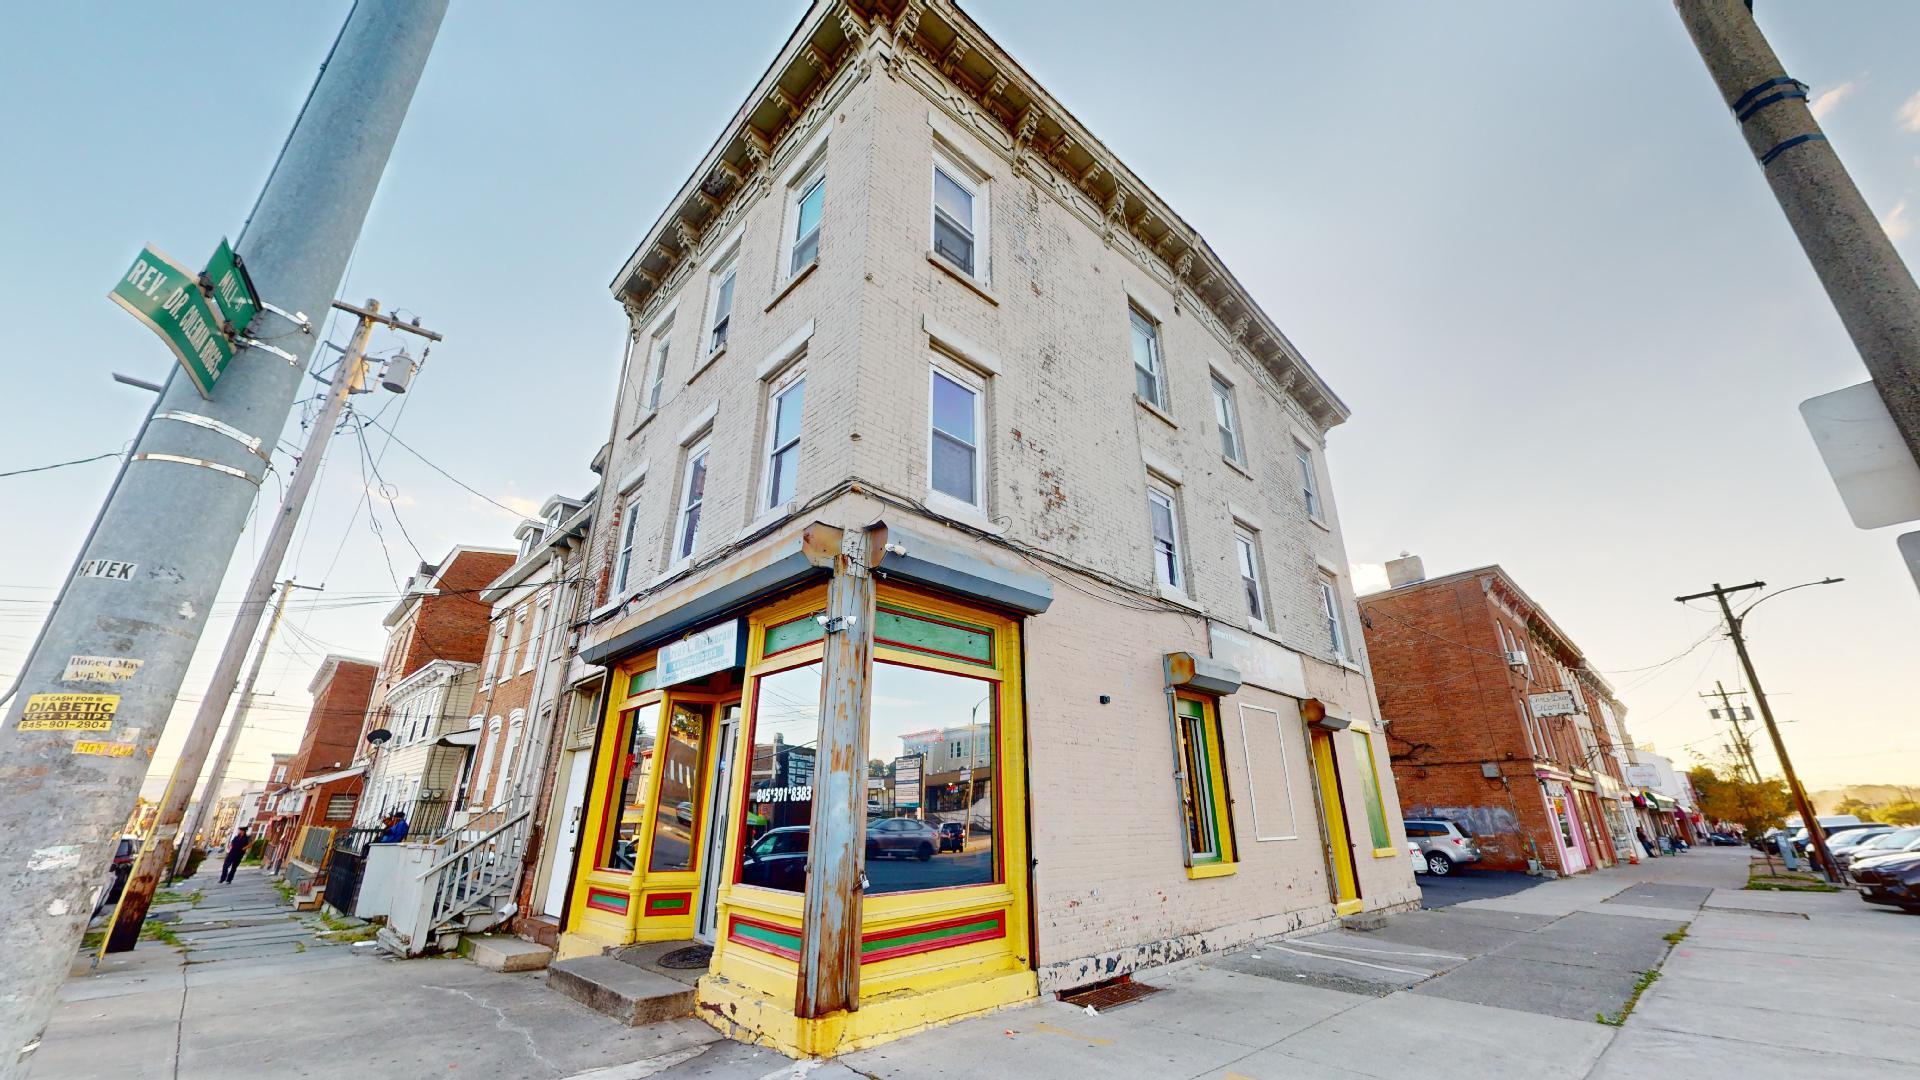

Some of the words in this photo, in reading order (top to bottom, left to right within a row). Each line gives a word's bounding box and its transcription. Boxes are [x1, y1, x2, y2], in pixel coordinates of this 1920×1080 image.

[127, 259, 168, 301] REV.
[162, 287, 190, 320] DR.
[218, 269, 238, 308] MILL
[26, 712, 54, 720] TEST
[59, 712, 110, 720] STRIPS
[28, 702, 114, 712] DIABETIC
